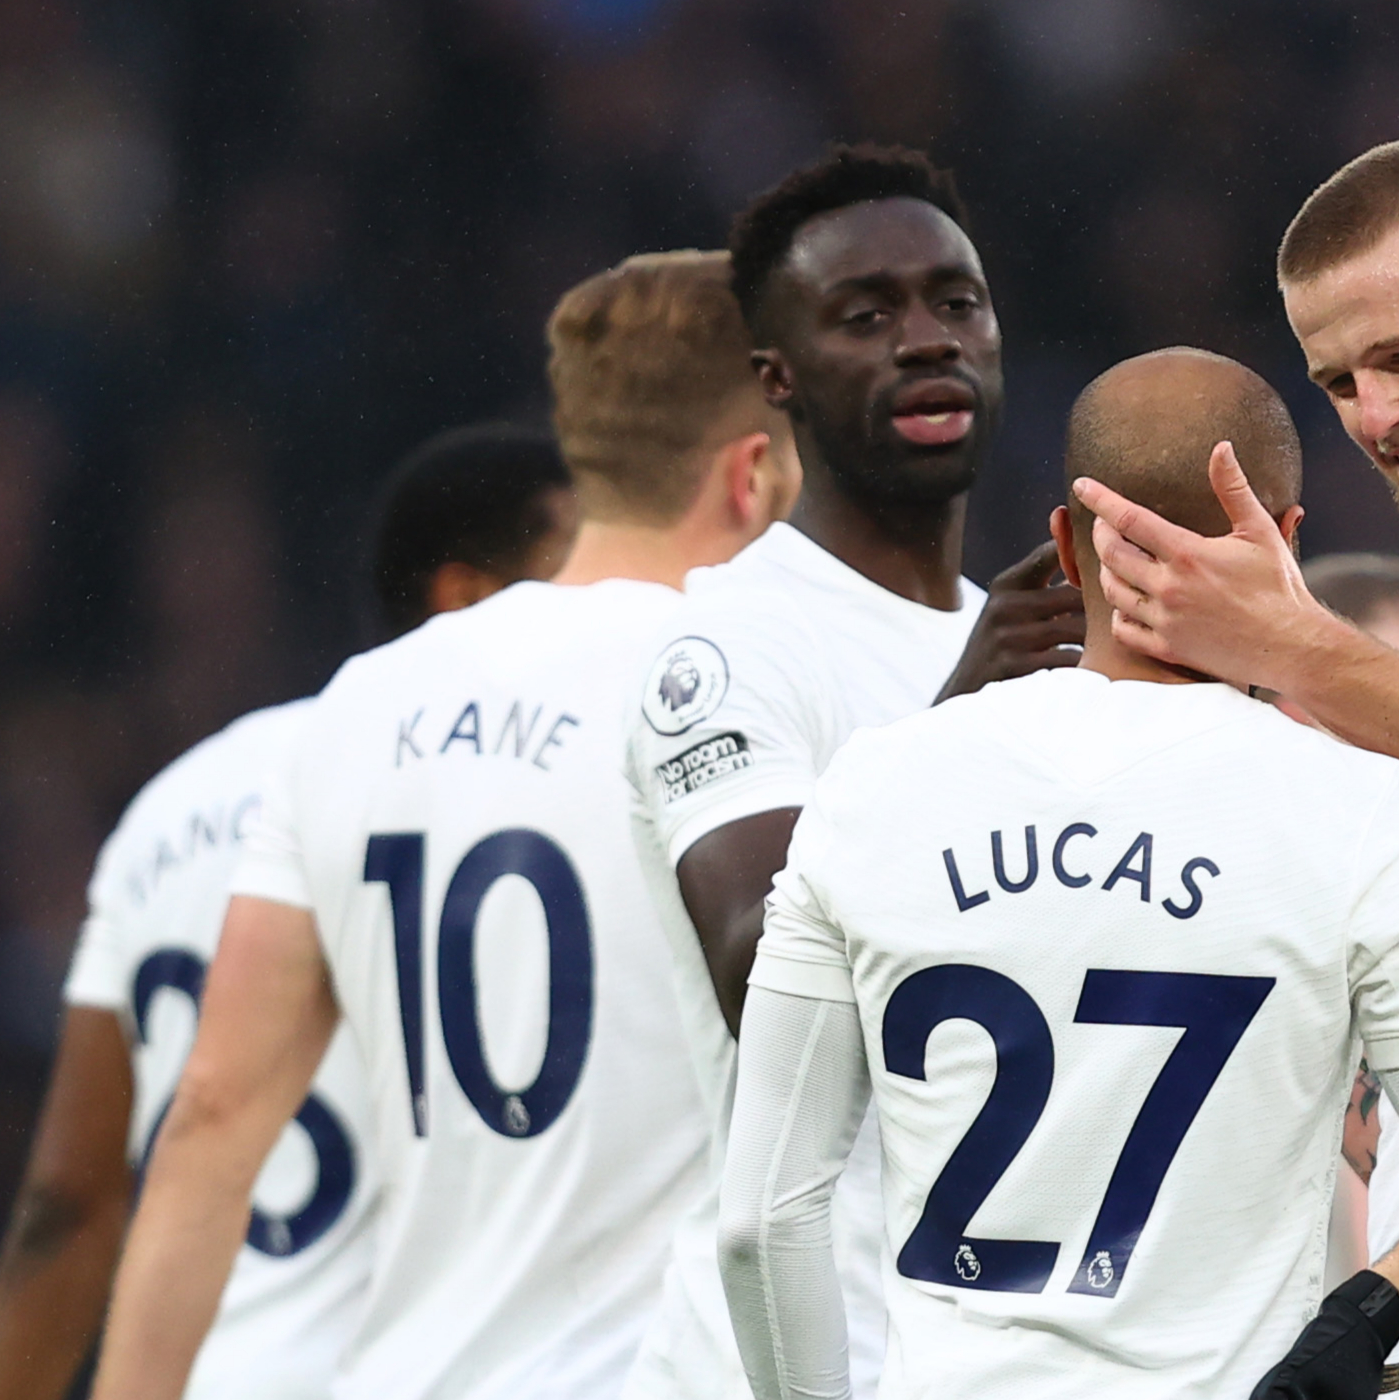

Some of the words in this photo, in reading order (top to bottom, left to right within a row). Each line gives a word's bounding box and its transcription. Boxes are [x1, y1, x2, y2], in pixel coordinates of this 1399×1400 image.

[395, 700, 580, 771] KANE
[656, 760, 685, 783] No
[683, 736, 738, 773] room
[687, 751, 752, 791] racism
[942, 822, 1221, 920] LUCAS
[362, 828, 595, 1140] 10
[881, 963, 1277, 1299] 27
